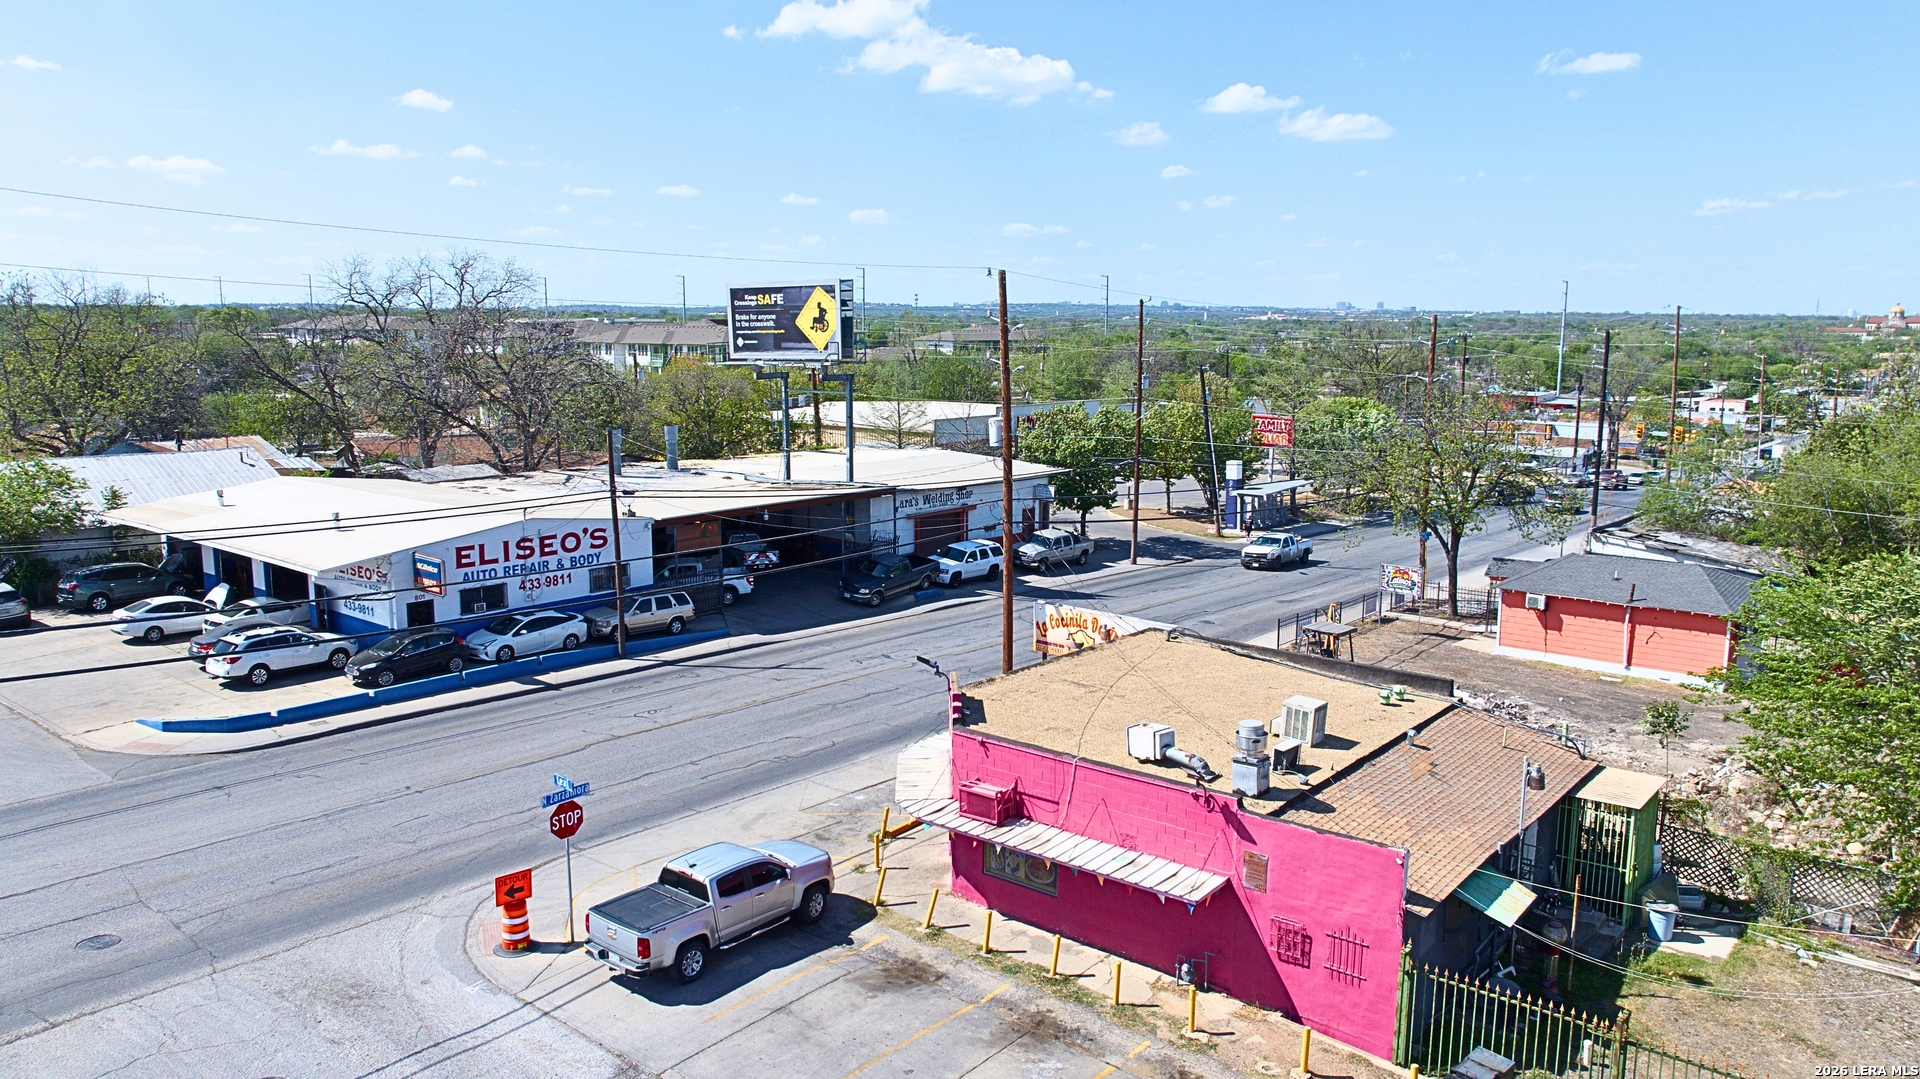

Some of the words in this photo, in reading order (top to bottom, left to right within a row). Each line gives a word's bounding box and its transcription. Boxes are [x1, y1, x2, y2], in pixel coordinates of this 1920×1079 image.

[757, 293, 784, 305] SAFE
[758, 314, 776, 322] anyone
[922, 490, 955, 506] Welding
[455, 527, 609, 569] ELISEO'S
[463, 567, 498, 582] AUTO
[503, 560, 550, 577] REPAIR
[556, 558, 565, 569] &
[570, 551, 602, 568] BODY
[518, 572, 573, 591] 433-9811
[343, 600, 375, 617] 433-9811
[550, 784, 589, 803] Zarzamora
[552, 809, 582, 831] STOP
[498, 873, 528, 887] DETOUR
